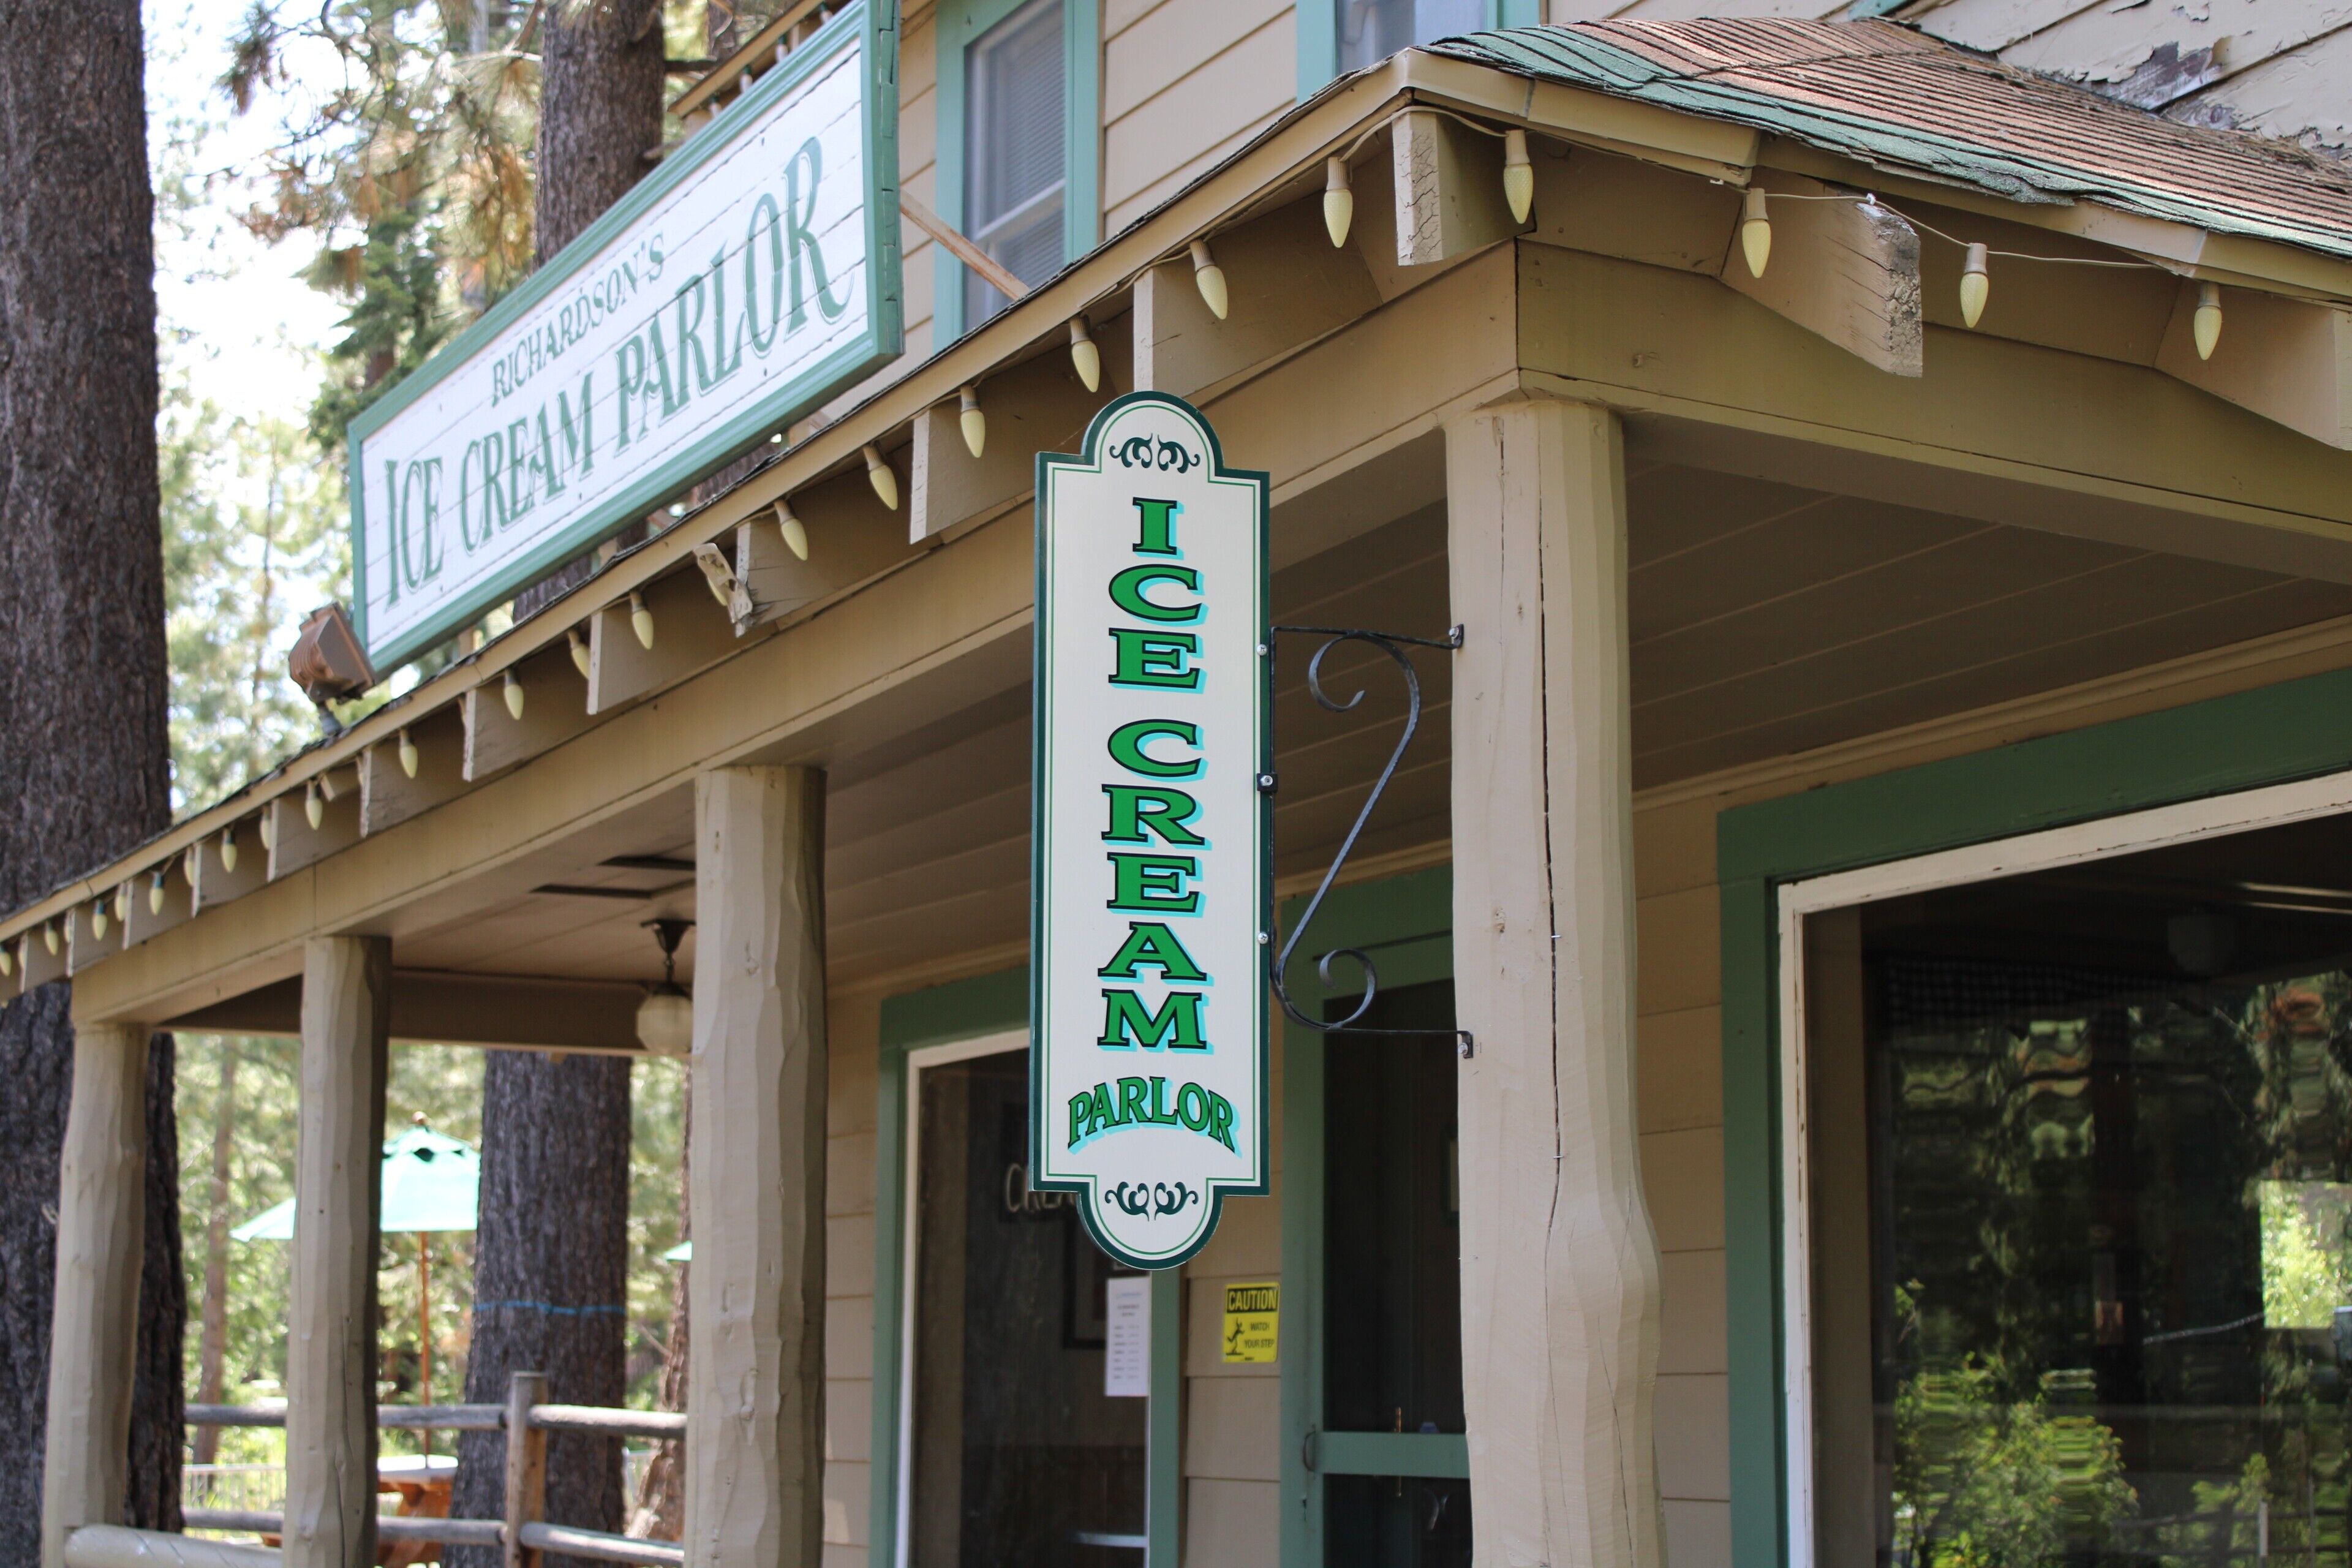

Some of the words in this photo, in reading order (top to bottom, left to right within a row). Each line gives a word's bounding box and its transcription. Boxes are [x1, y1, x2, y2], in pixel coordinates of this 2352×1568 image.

[384, 456, 445, 612] ICE
[461, 369, 595, 556] CREAM
[614, 136, 855, 458] PARLOR
[491, 231, 665, 408] RICHARDSON'S
[1108, 497, 1209, 694] ICE
[1096, 718, 1215, 1055] CREAM
[1068, 1076, 1242, 1159] PARLOR
[1229, 1289, 1277, 1311] CAUTION
[1244, 1340, 1260, 1349] YOUR
[1261, 1338, 1275, 1348] STEP
[1250, 1322, 1270, 1332] WATCH
